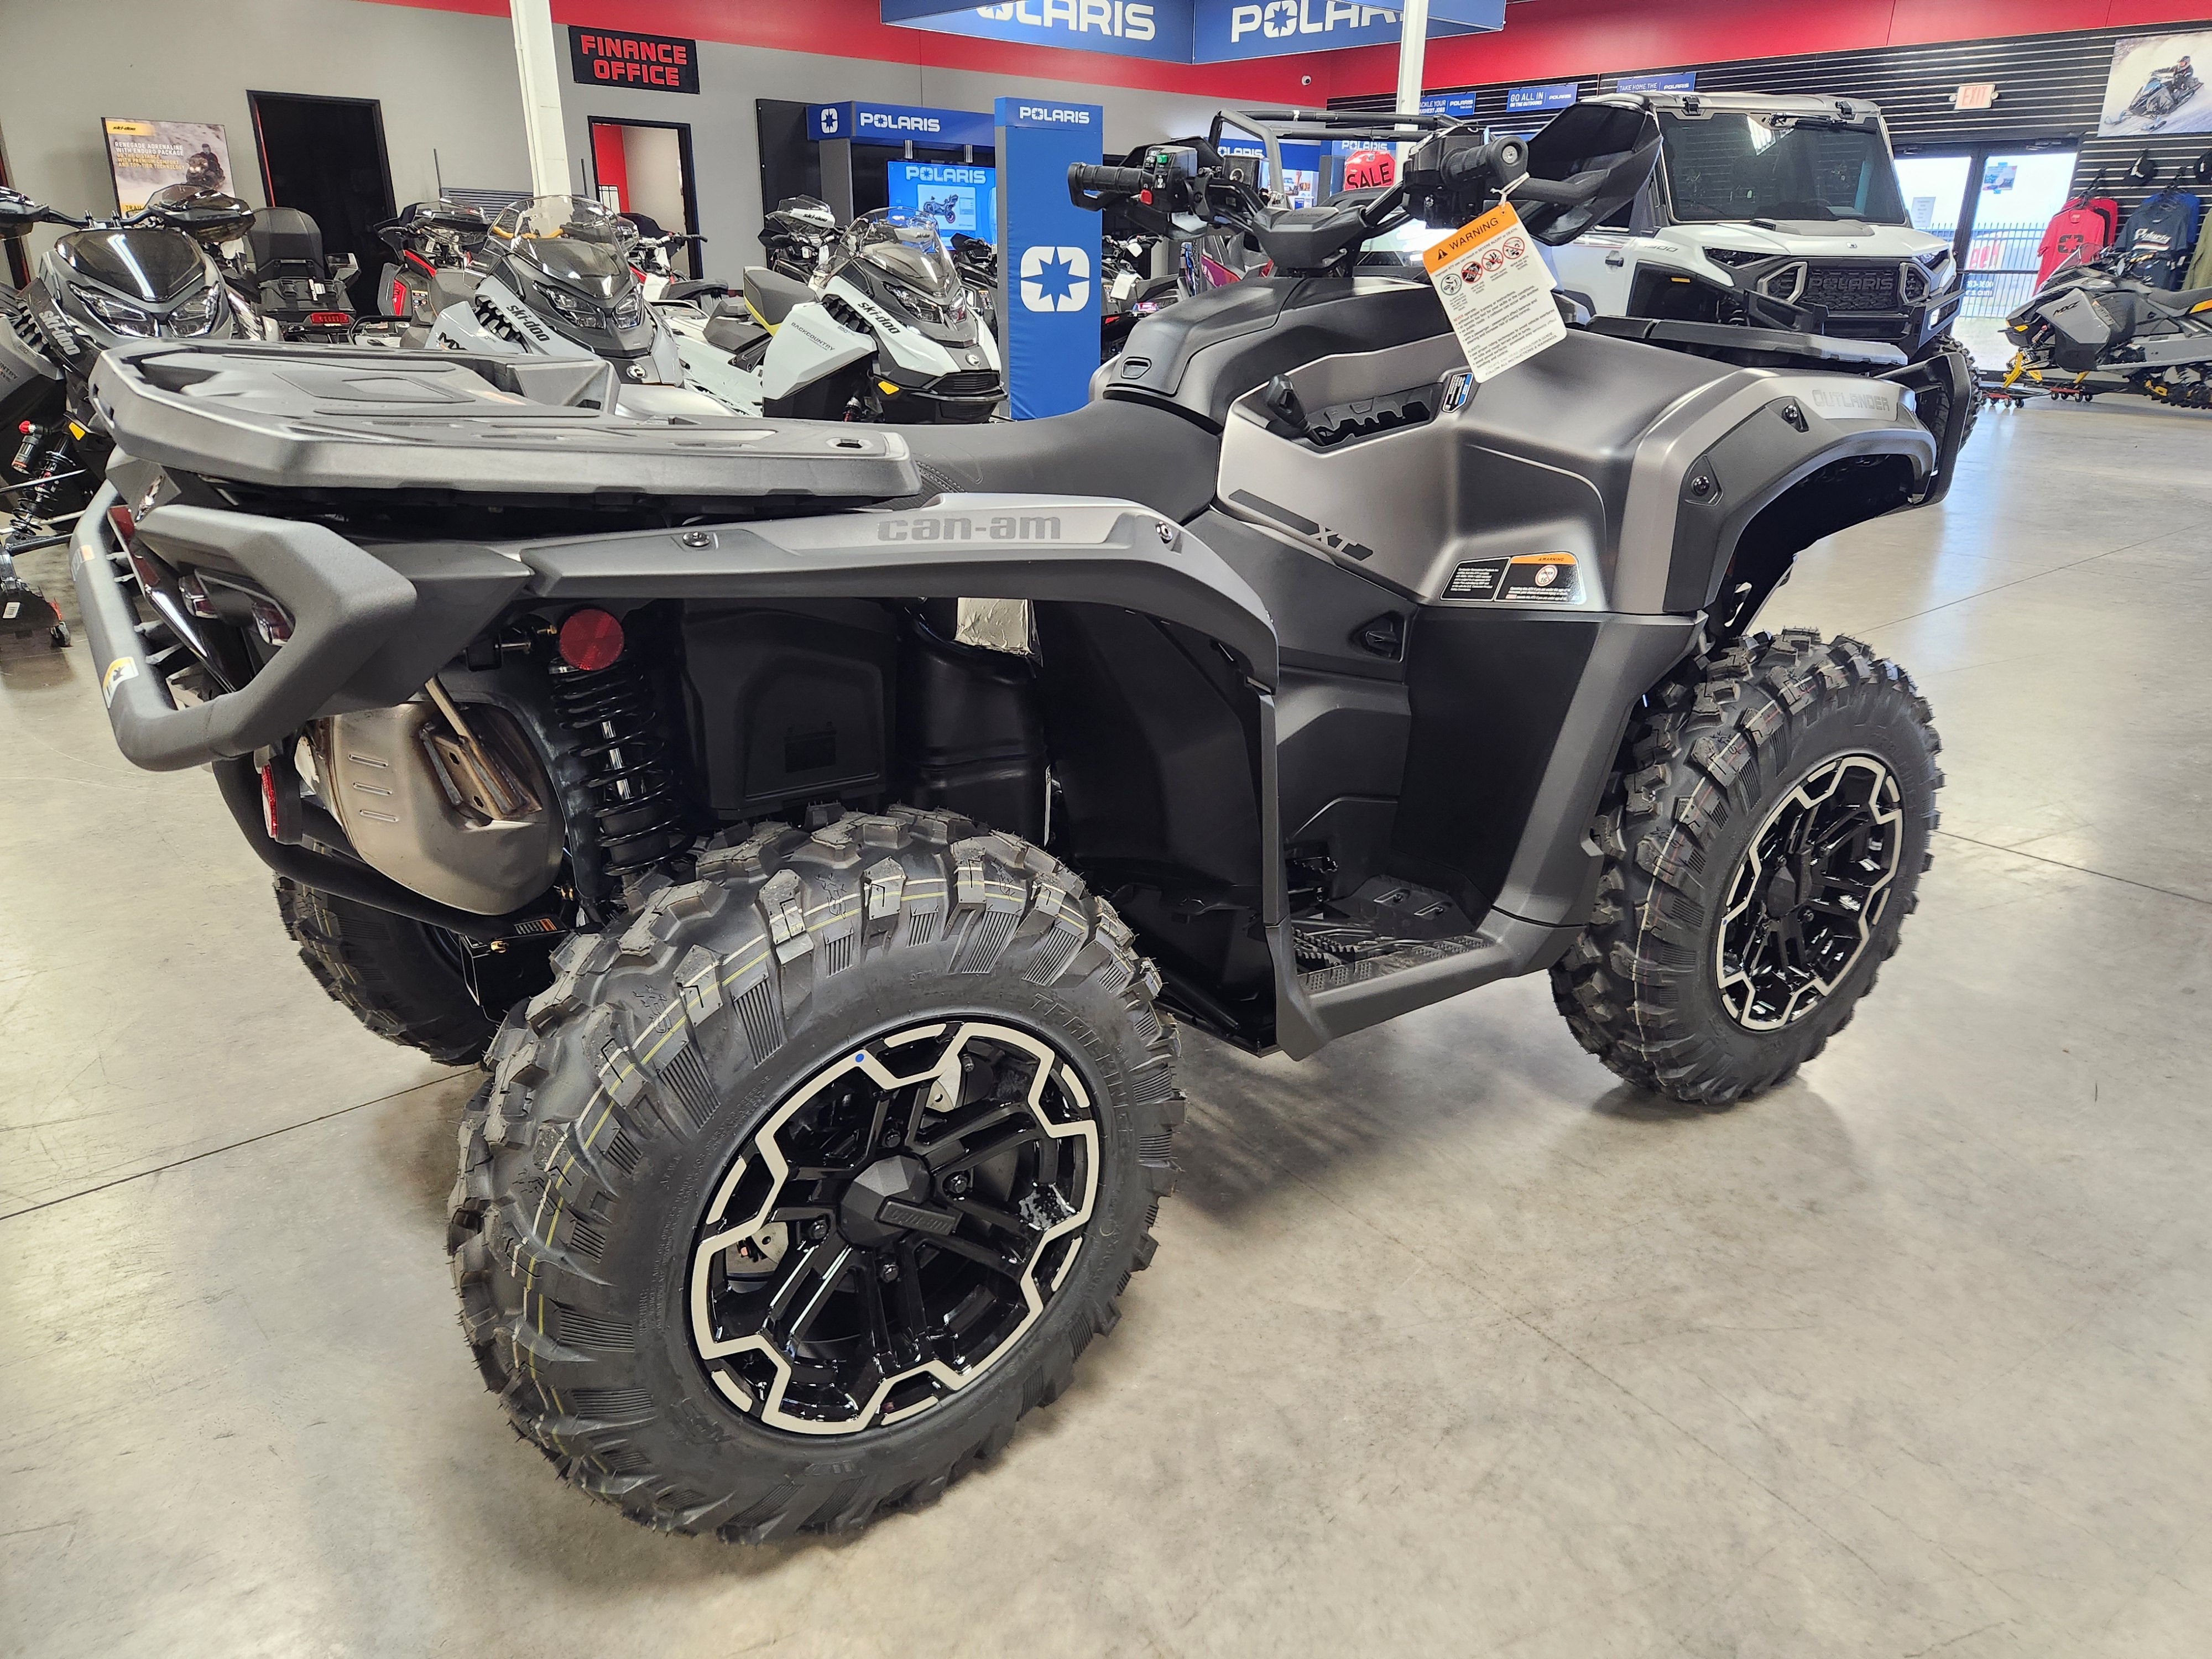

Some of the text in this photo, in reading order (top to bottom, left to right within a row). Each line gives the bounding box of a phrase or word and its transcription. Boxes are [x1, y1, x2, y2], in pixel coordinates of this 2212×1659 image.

[976, 0, 1156, 41] LARIS
[1231, 0, 1404, 43] POLAR
[581, 35, 687, 65] FINANCE
[593, 59, 680, 86] OFFICE
[1510, 91, 1544, 102] GO ALL IN
[1962, 86, 1988, 106] EXIT
[860, 112, 940, 133] POLARIS
[1019, 106, 1090, 124] POLARIS
[1217, 146, 1263, 157] OLARIS
[905, 166, 986, 184] POLARIS
[1347, 161, 1392, 189] SALE
[802, 213, 828, 222] ski-doo
[1449, 217, 1499, 251] WARNING
[1808, 278, 1893, 290] POLARIS
[505, 305, 550, 342] ski-doo
[858, 301, 901, 335] ski-doo
[39, 310, 81, 356] ski-doo
[791, 322, 836, 351] BACKCOUNTRY
[877, 515, 1061, 542] can-am
